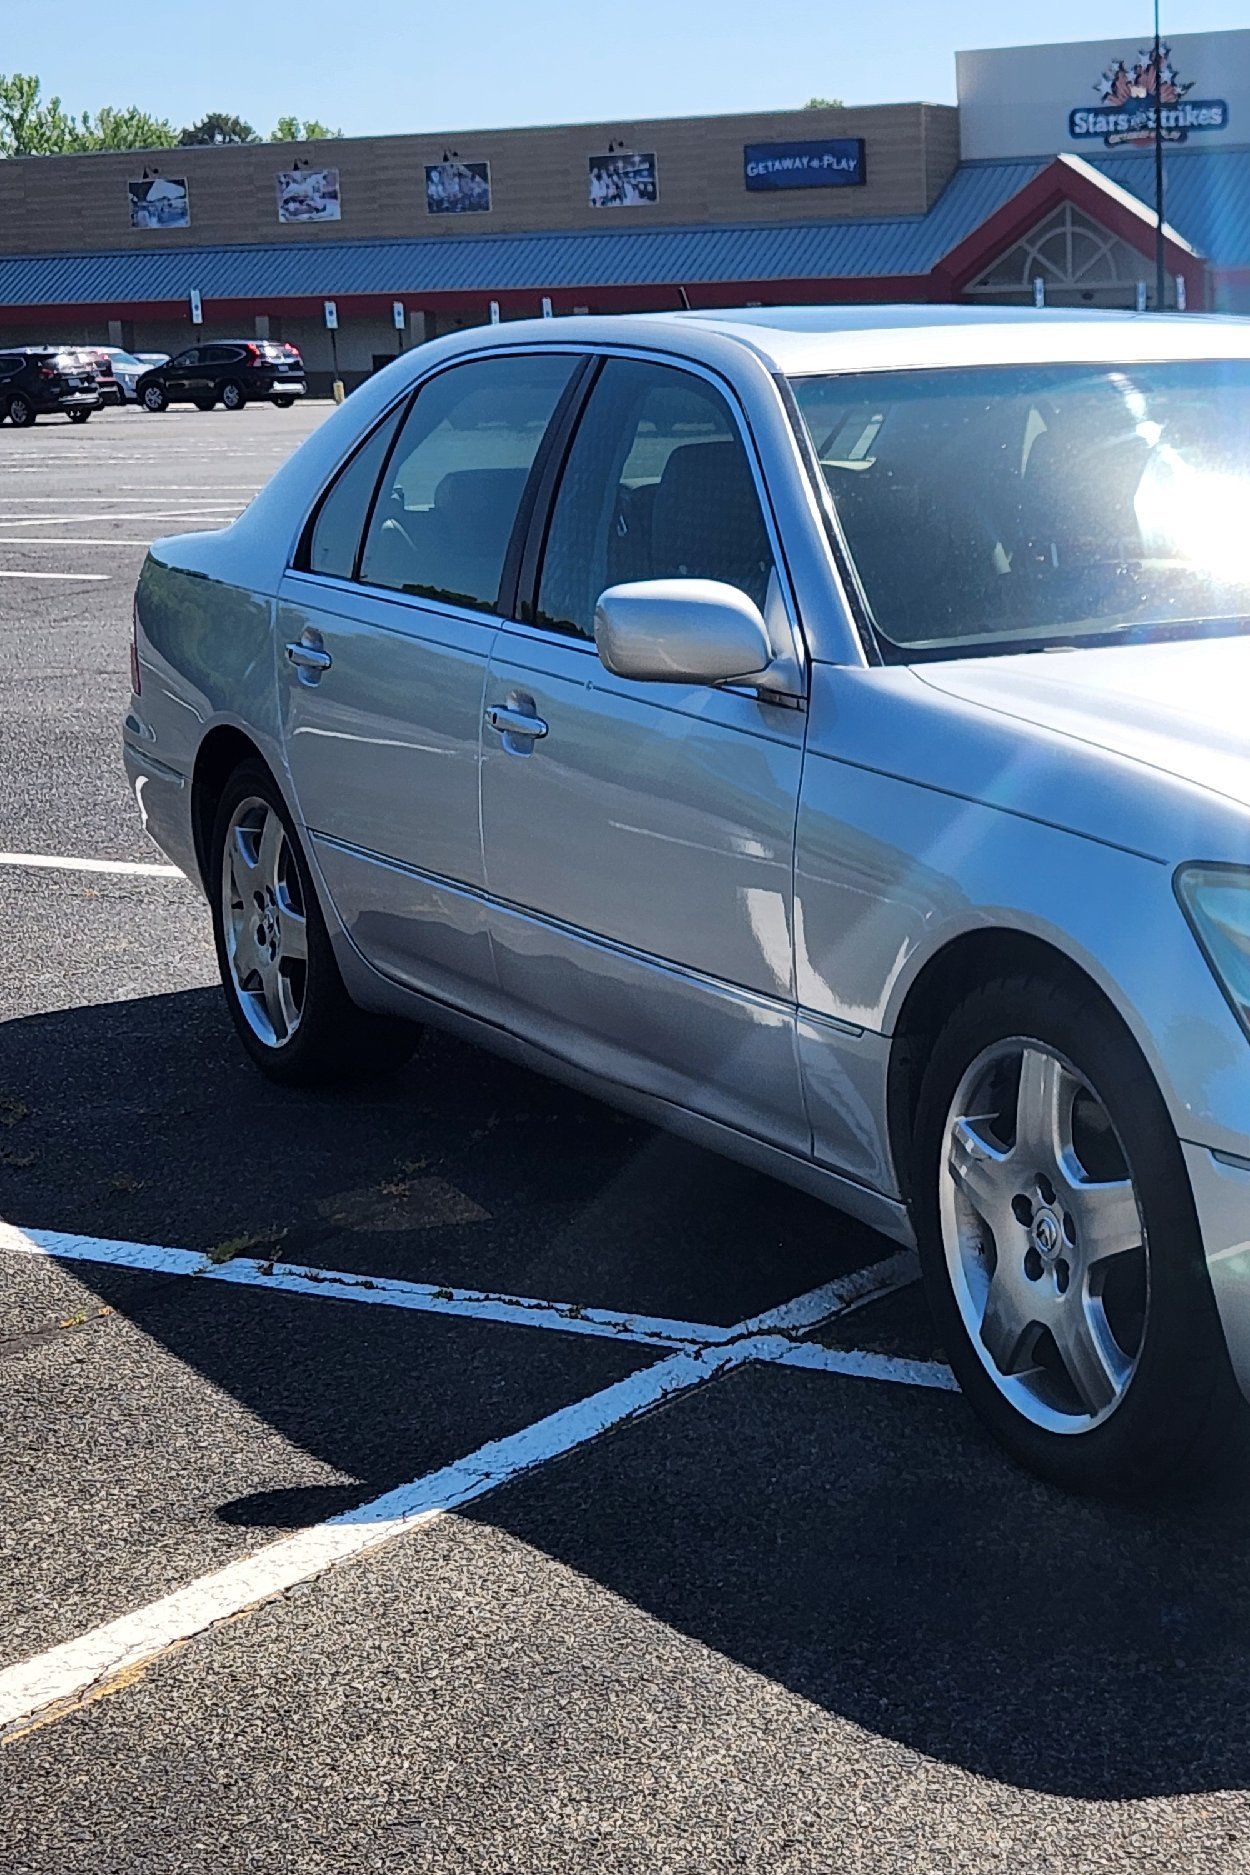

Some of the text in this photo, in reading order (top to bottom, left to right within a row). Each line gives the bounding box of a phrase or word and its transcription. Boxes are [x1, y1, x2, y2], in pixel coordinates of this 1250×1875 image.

[1073, 111, 1129, 134] Stars
[1146, 104, 1223, 129] Strikes
[746, 155, 809, 177] GETAWAY
[823, 153, 857, 172] PLAY
